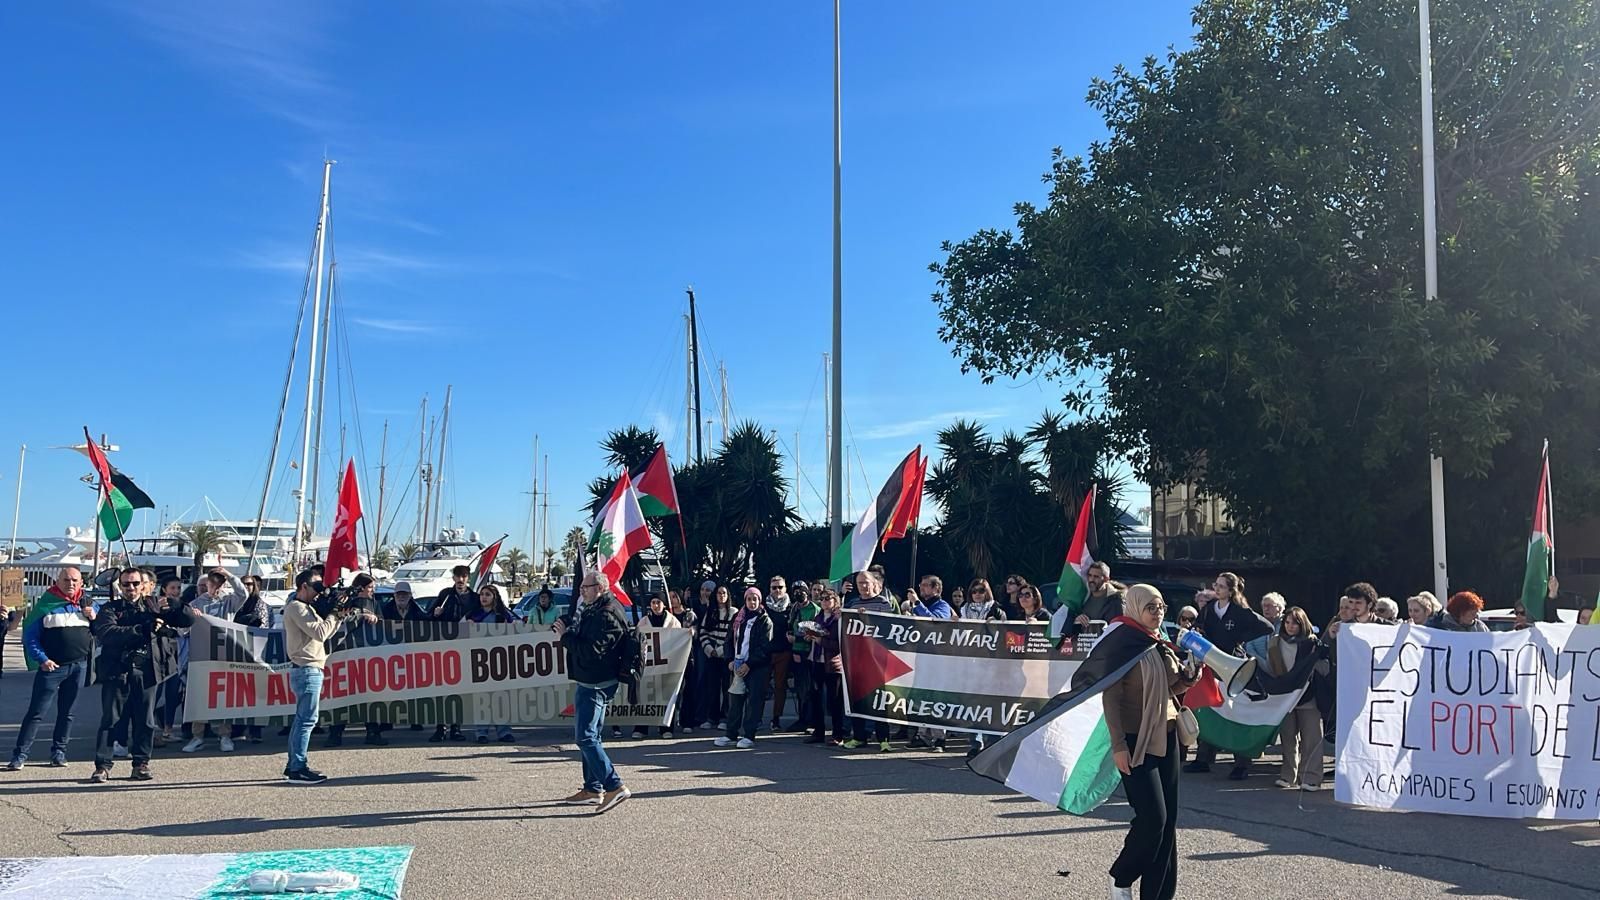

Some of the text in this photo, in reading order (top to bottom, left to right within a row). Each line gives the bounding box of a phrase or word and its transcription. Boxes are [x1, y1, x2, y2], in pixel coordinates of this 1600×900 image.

[924, 632, 946, 646] AL
[950, 628, 999, 651] MAR!
[1010, 645, 1025, 653] PCPE
[208, 671, 256, 709] FIN
[320, 650, 462, 700] GENOCIDIO
[470, 640, 566, 683] BOICOT
[1370, 642, 1600, 702] ESTUDIANTS
[611, 704, 629, 717] POR
[630, 704, 667, 717] PALESTI
[872, 689, 993, 725] ¡PALESTINA
[1368, 700, 1421, 751] EL
[1431, 701, 1522, 756] PORT
[1530, 704, 1576, 759] DE
[1361, 772, 1476, 802] ACAMPADES
[1506, 783, 1587, 810] ESUDIANTS
